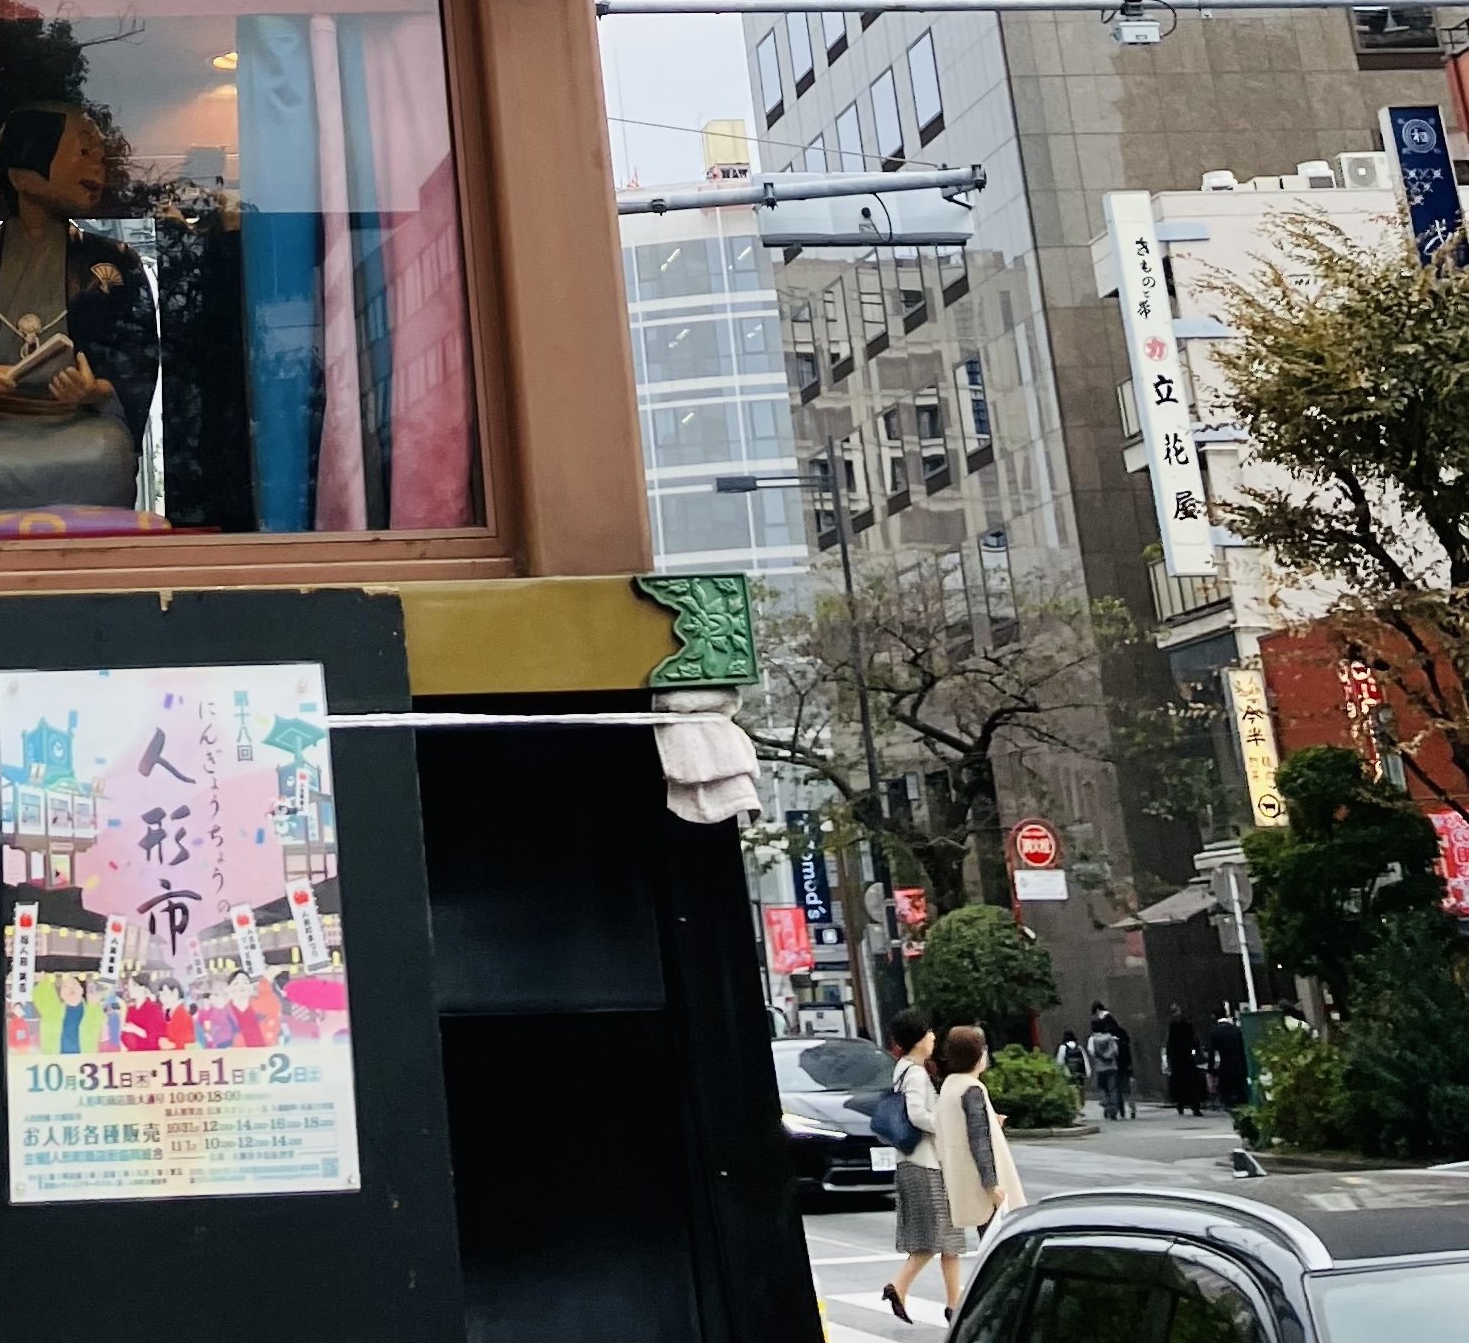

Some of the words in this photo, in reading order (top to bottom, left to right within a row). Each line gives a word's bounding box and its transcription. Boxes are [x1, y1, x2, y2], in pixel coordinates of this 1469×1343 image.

[1151, 373, 1199, 522] 立花屋
[136, 725, 203, 957] 人形市
